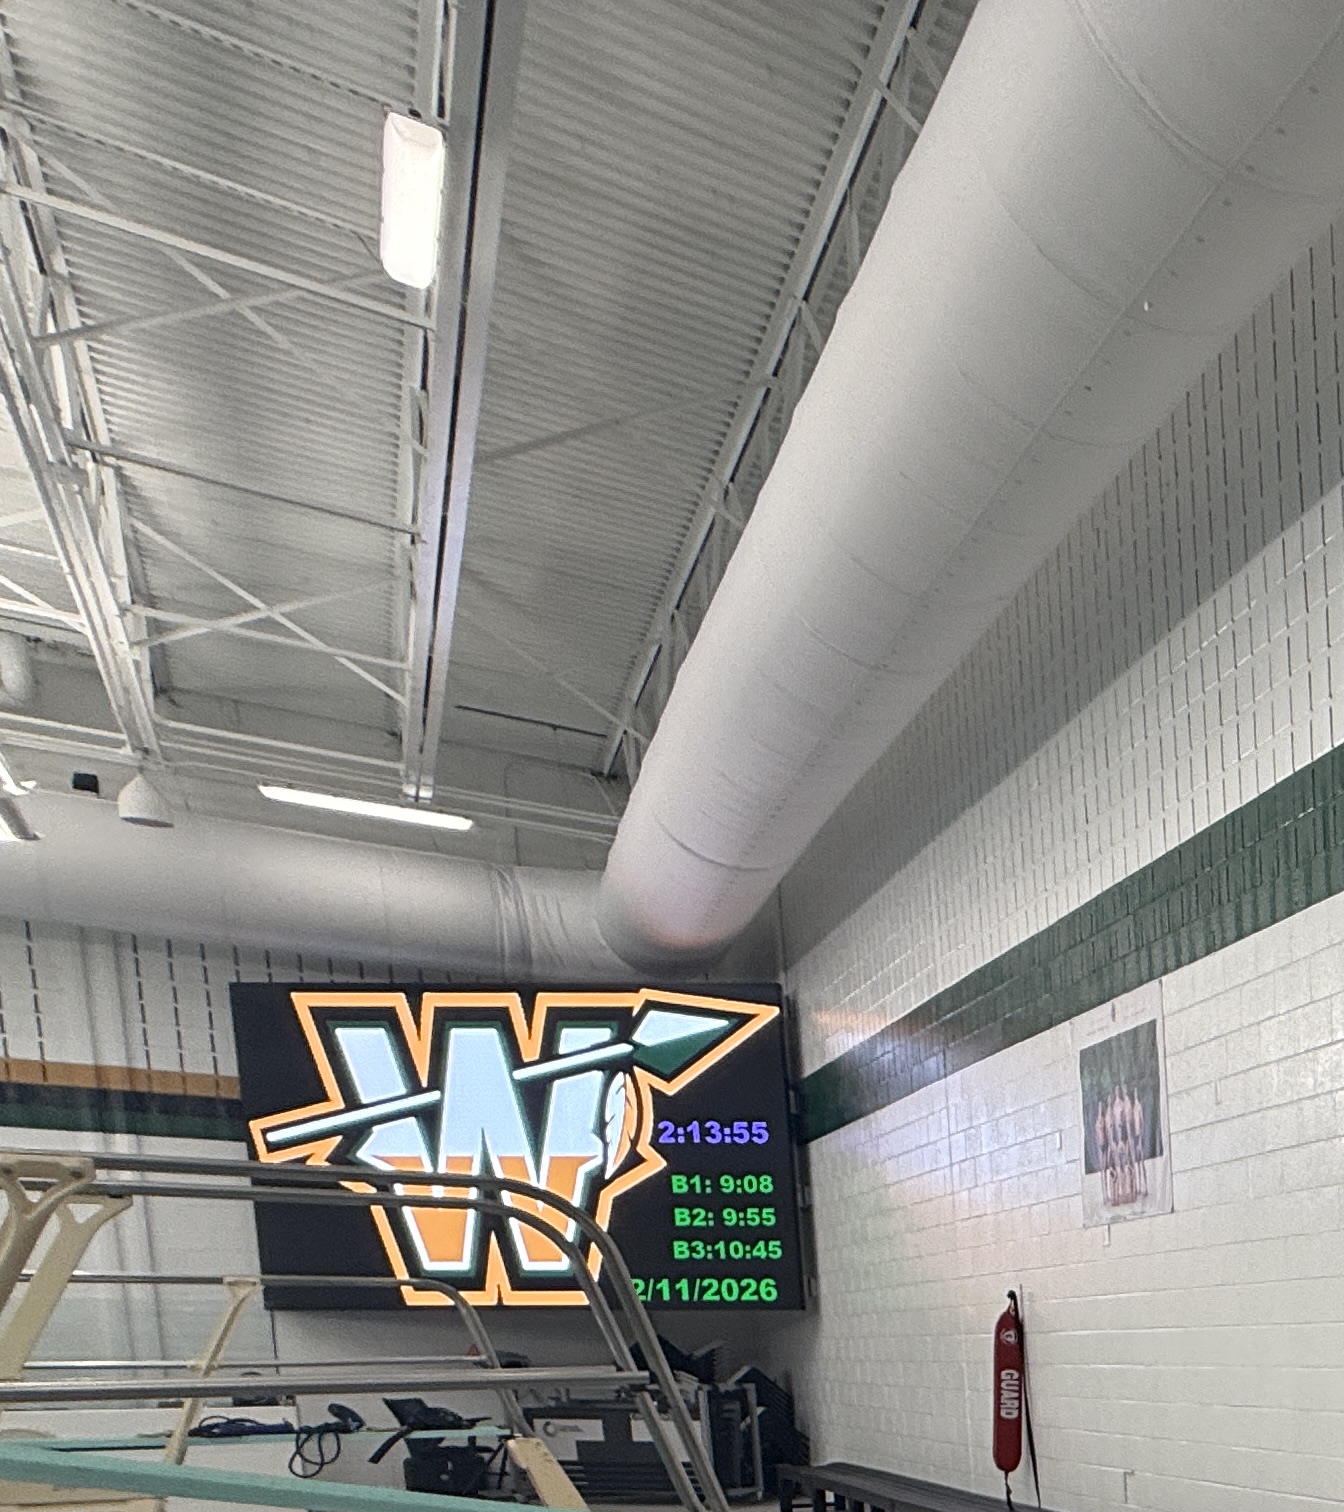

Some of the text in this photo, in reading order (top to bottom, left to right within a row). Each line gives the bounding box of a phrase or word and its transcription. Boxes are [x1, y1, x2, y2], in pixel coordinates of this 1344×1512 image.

[658, 1120, 770, 1145] 2:13:55
[671, 1174, 774, 1194] B1: 9:08
[674, 1207, 777, 1227] B2: 9:55
[673, 1240, 783, 1260] B3:10:45
[631, 1278, 778, 1302] 2/11/2026
[1000, 1368, 1020, 1419] GUARD
